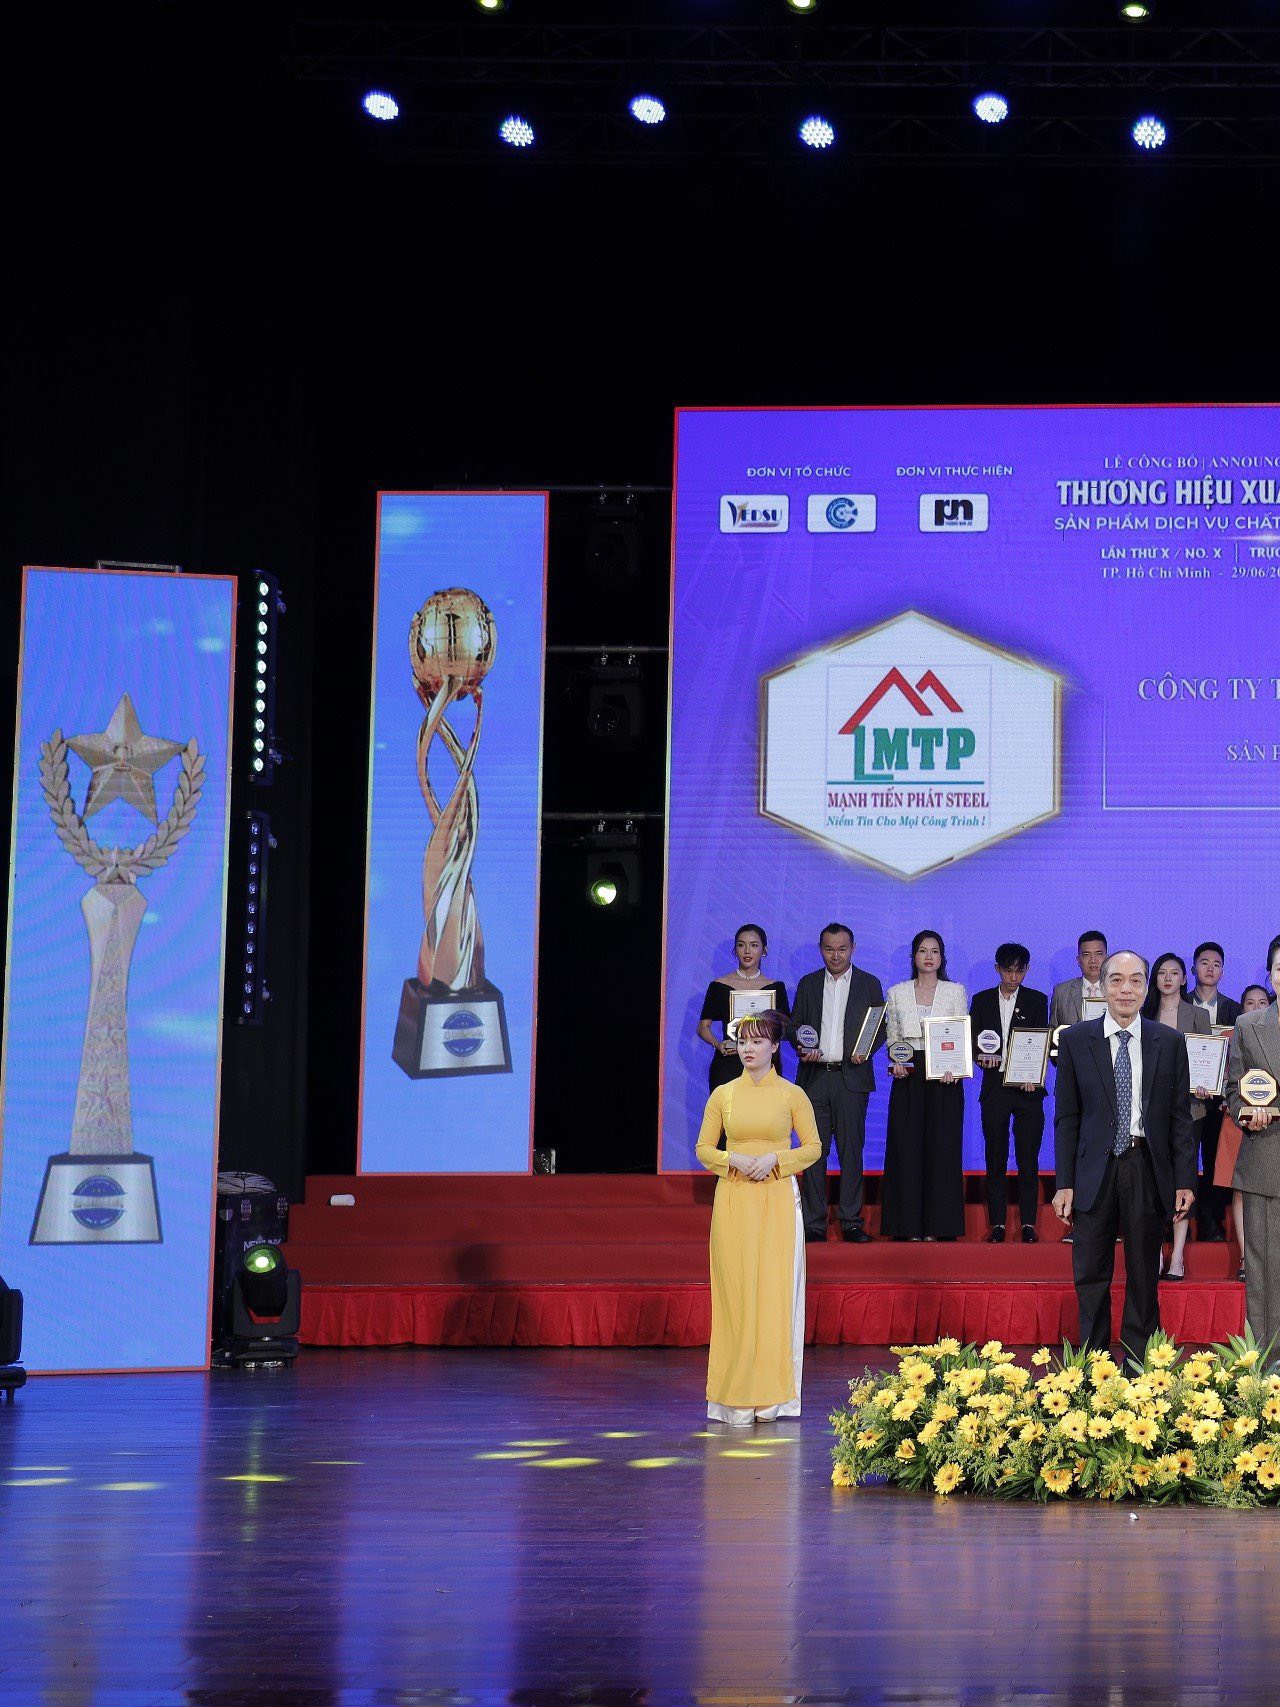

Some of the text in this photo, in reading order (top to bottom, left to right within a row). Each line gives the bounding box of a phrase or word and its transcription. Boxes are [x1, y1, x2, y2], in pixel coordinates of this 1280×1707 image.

[1128, 454, 1172, 469] CÔNG
[747, 467, 776, 477] ĐƠN
[779, 467, 791, 479] VỊ
[816, 466, 851, 477] CHỨC
[896, 465, 1013, 478] ĐƠN VỊ THỰC HIỆN
[1057, 479, 1166, 506] THƯƠNG
[1175, 475, 1232, 510] HIỆU
[1054, 514, 1090, 530] SẢN
[1155, 516, 1199, 532] DỊCH
[1204, 516, 1229, 532] VỤ
[1161, 548, 1170, 559] X
[1185, 548, 1209, 559] NO.
[1213, 548, 1222, 559] X
[1101, 567, 1121, 578] TP.
[1126, 564, 1145, 578] Hồ
[1149, 566, 1172, 578] Chí
[1177, 567, 1211, 578] Minh
[1138, 671, 1219, 700] CÔNG
[1228, 678, 1262, 700] TY
[1227, 741, 1266, 761] SẢN
[828, 787, 989, 812] MẠNH TIẾN PHÁT STEEL
[857, 815, 873, 826] Tin
[876, 815, 896, 826] Cho
[899, 816, 918, 828] Mọi
[922, 816, 948, 827] Công
